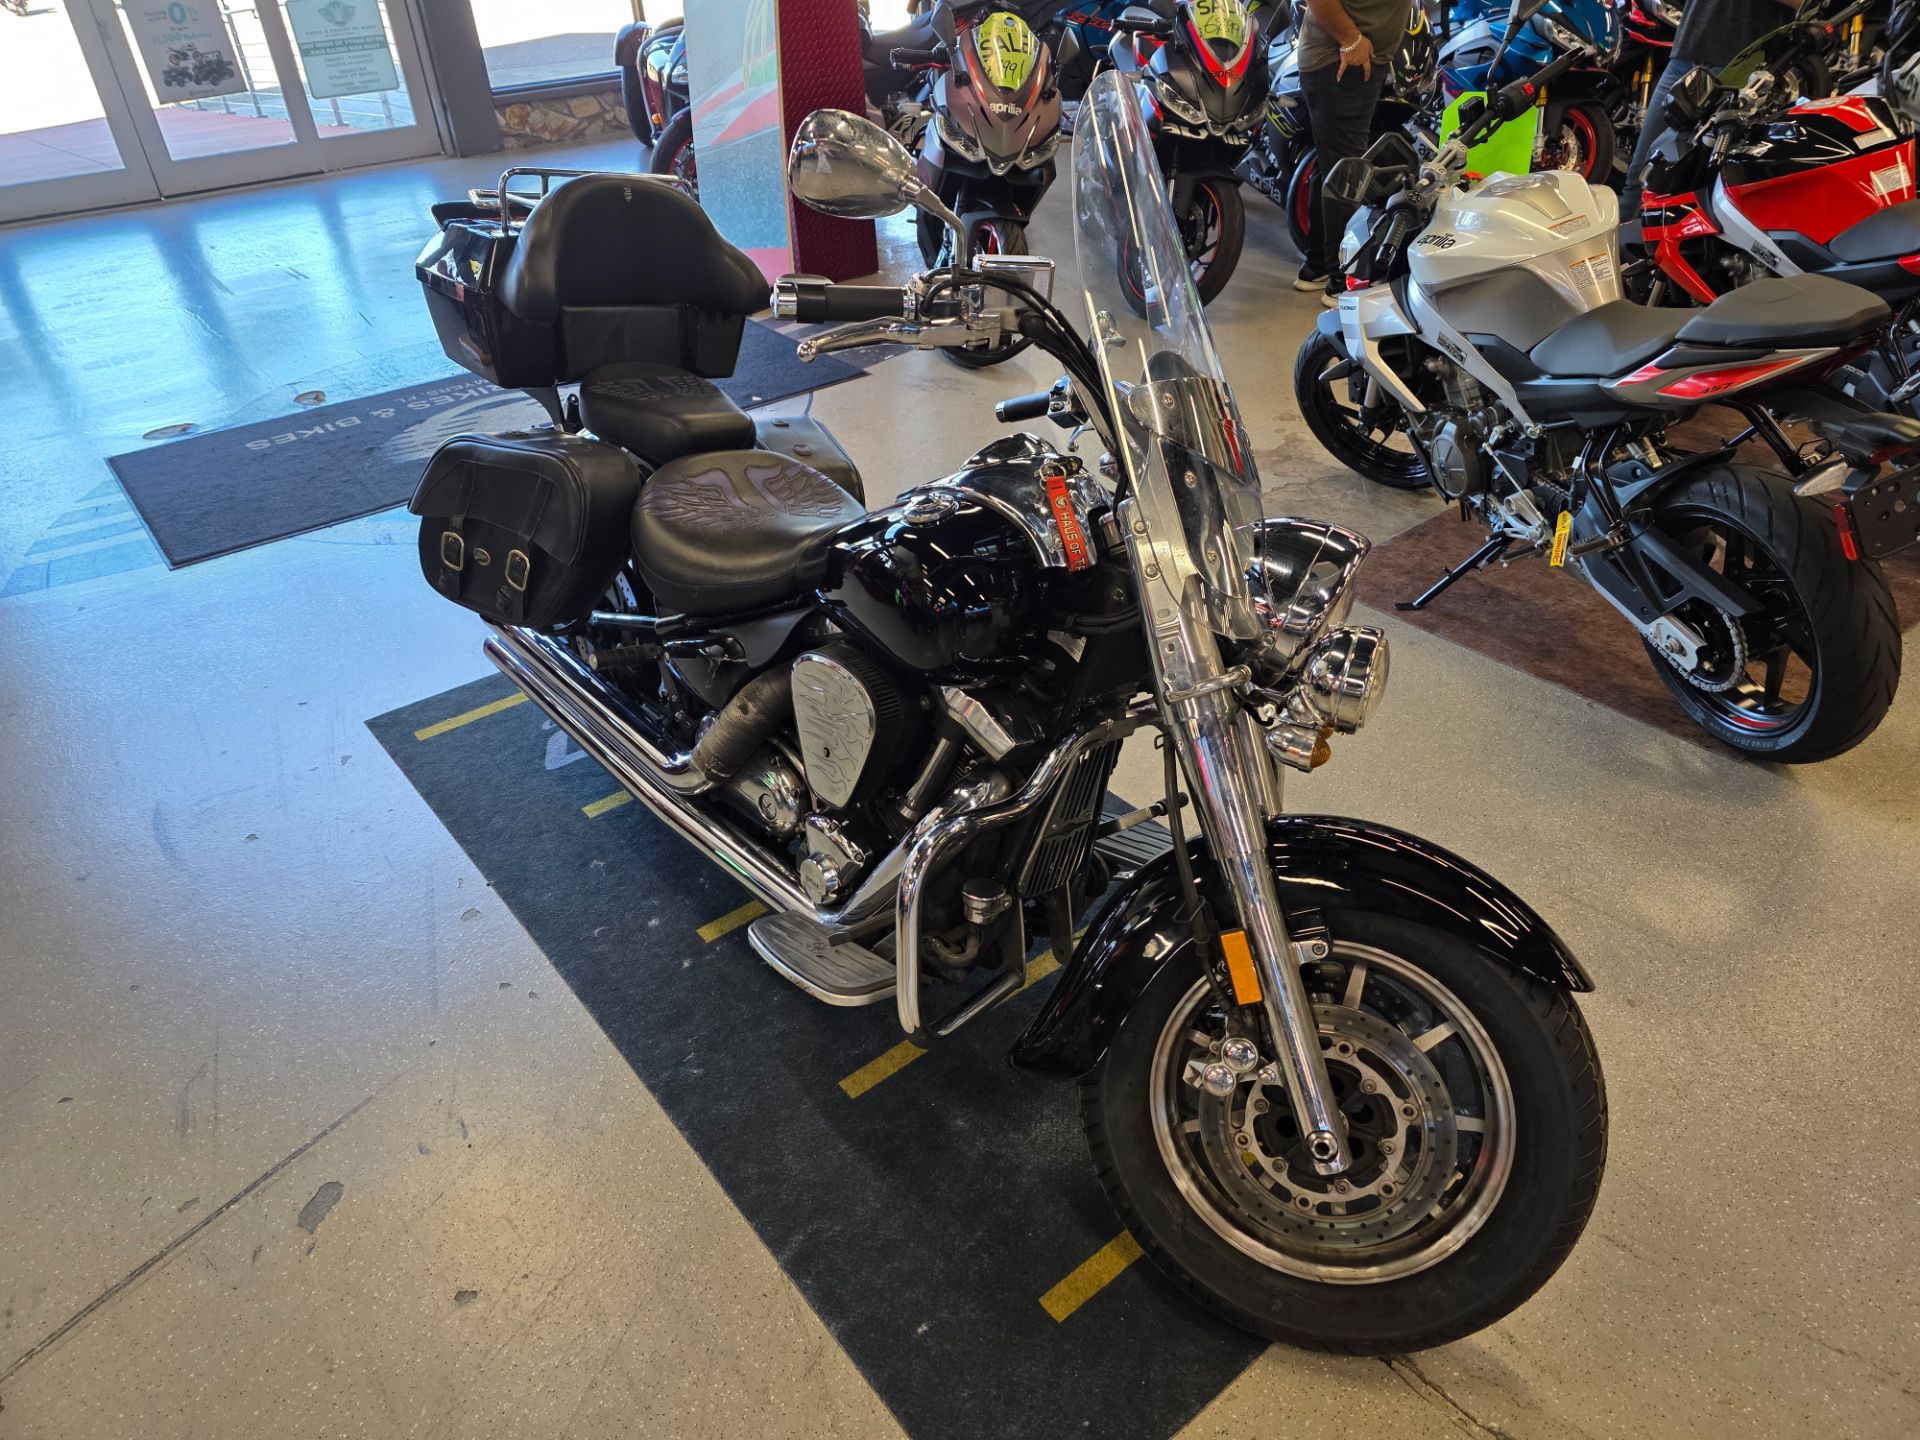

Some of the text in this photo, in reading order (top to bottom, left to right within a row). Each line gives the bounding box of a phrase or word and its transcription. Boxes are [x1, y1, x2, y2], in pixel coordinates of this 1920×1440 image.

[989, 102, 1022, 116] aprilia
[1417, 233, 1457, 249] aprilia
[1702, 381, 1735, 394] 457
[245, 384, 505, 450] RIKES & BIKES
[1060, 512, 1078, 541] HAUS
[1069, 543, 1082, 555] OF
